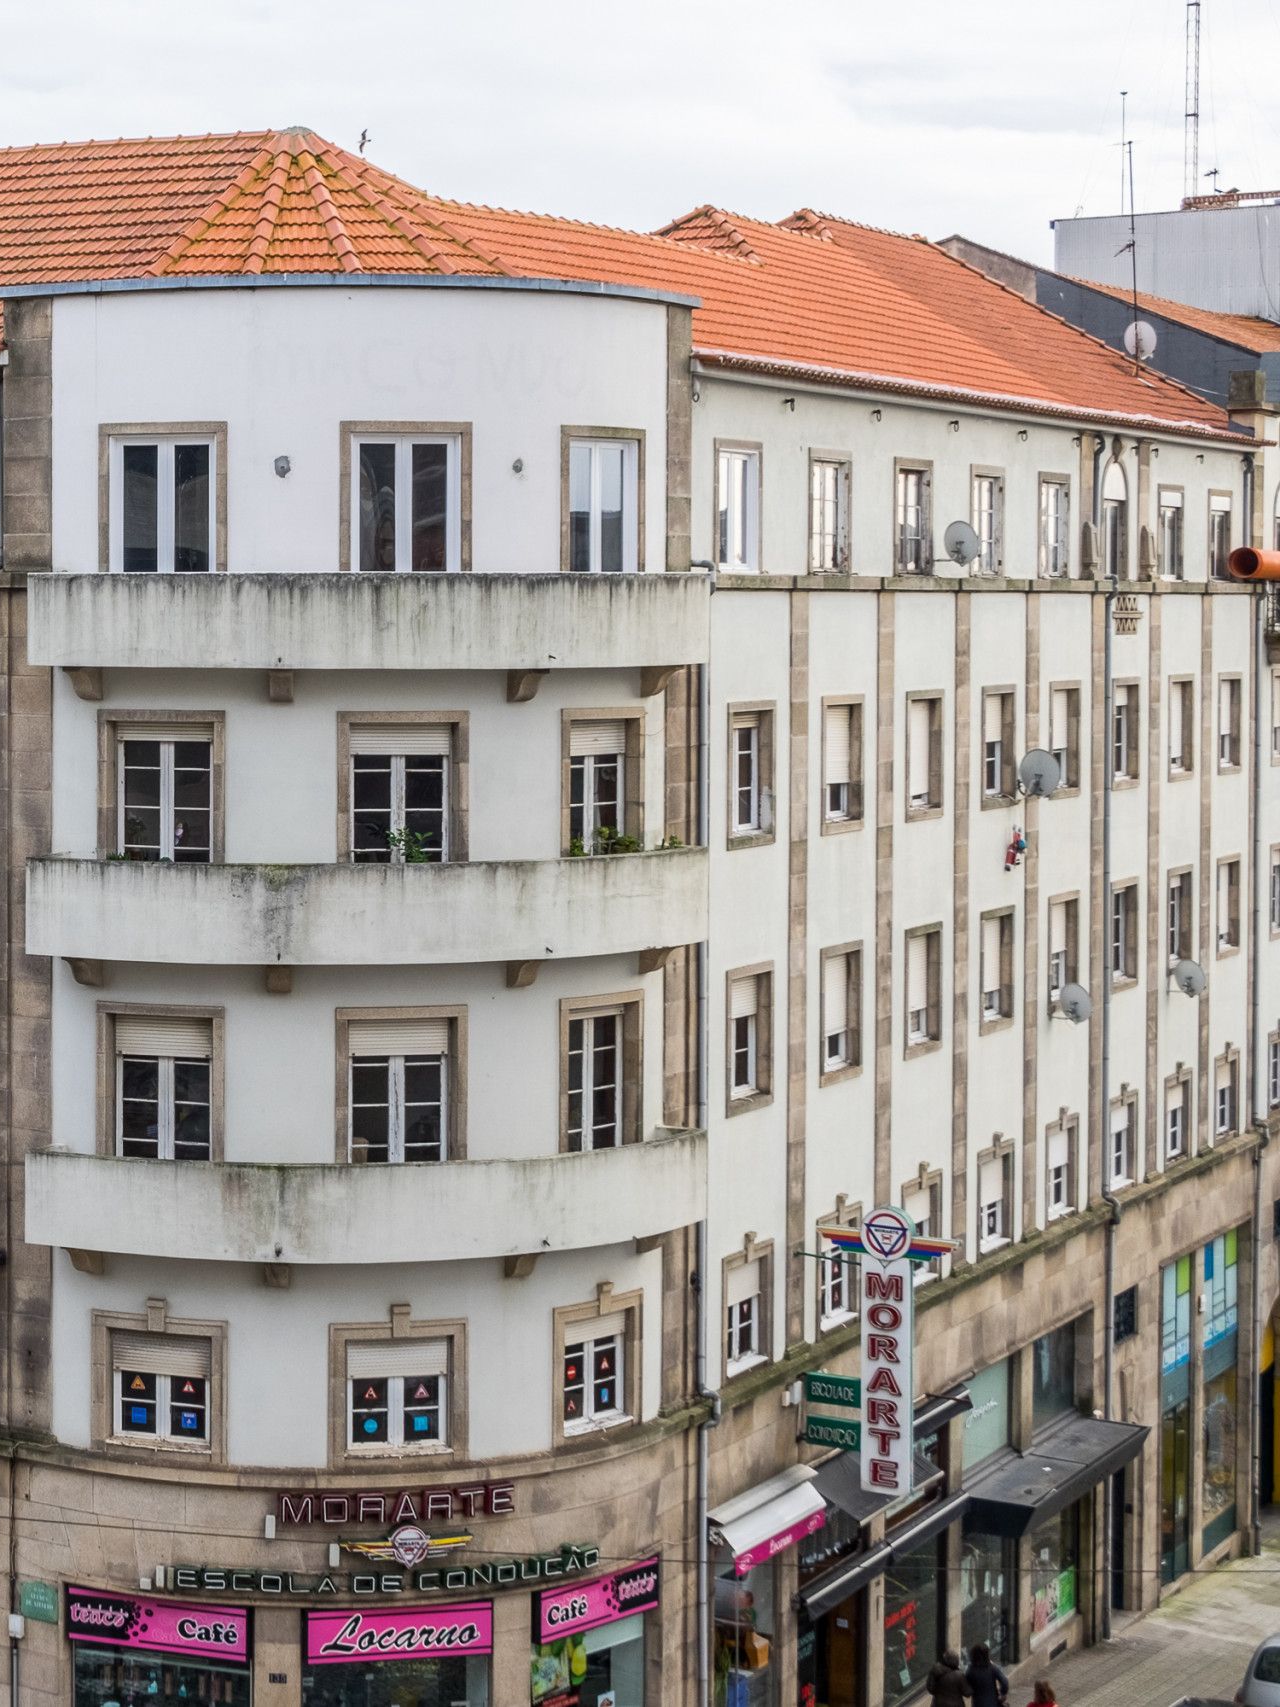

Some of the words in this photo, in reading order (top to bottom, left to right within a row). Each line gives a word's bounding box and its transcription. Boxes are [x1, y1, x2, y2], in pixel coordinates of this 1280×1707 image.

[866, 1272, 904, 1489] MORARTE
[278, 1482, 515, 1524] MORARTE
[176, 1566, 338, 1594] ESCOLA
[352, 1570, 404, 1594] DE
[546, 1594, 588, 1626] Café
[177, 1618, 239, 1645] Café
[320, 1613, 481, 1655] Locarno
